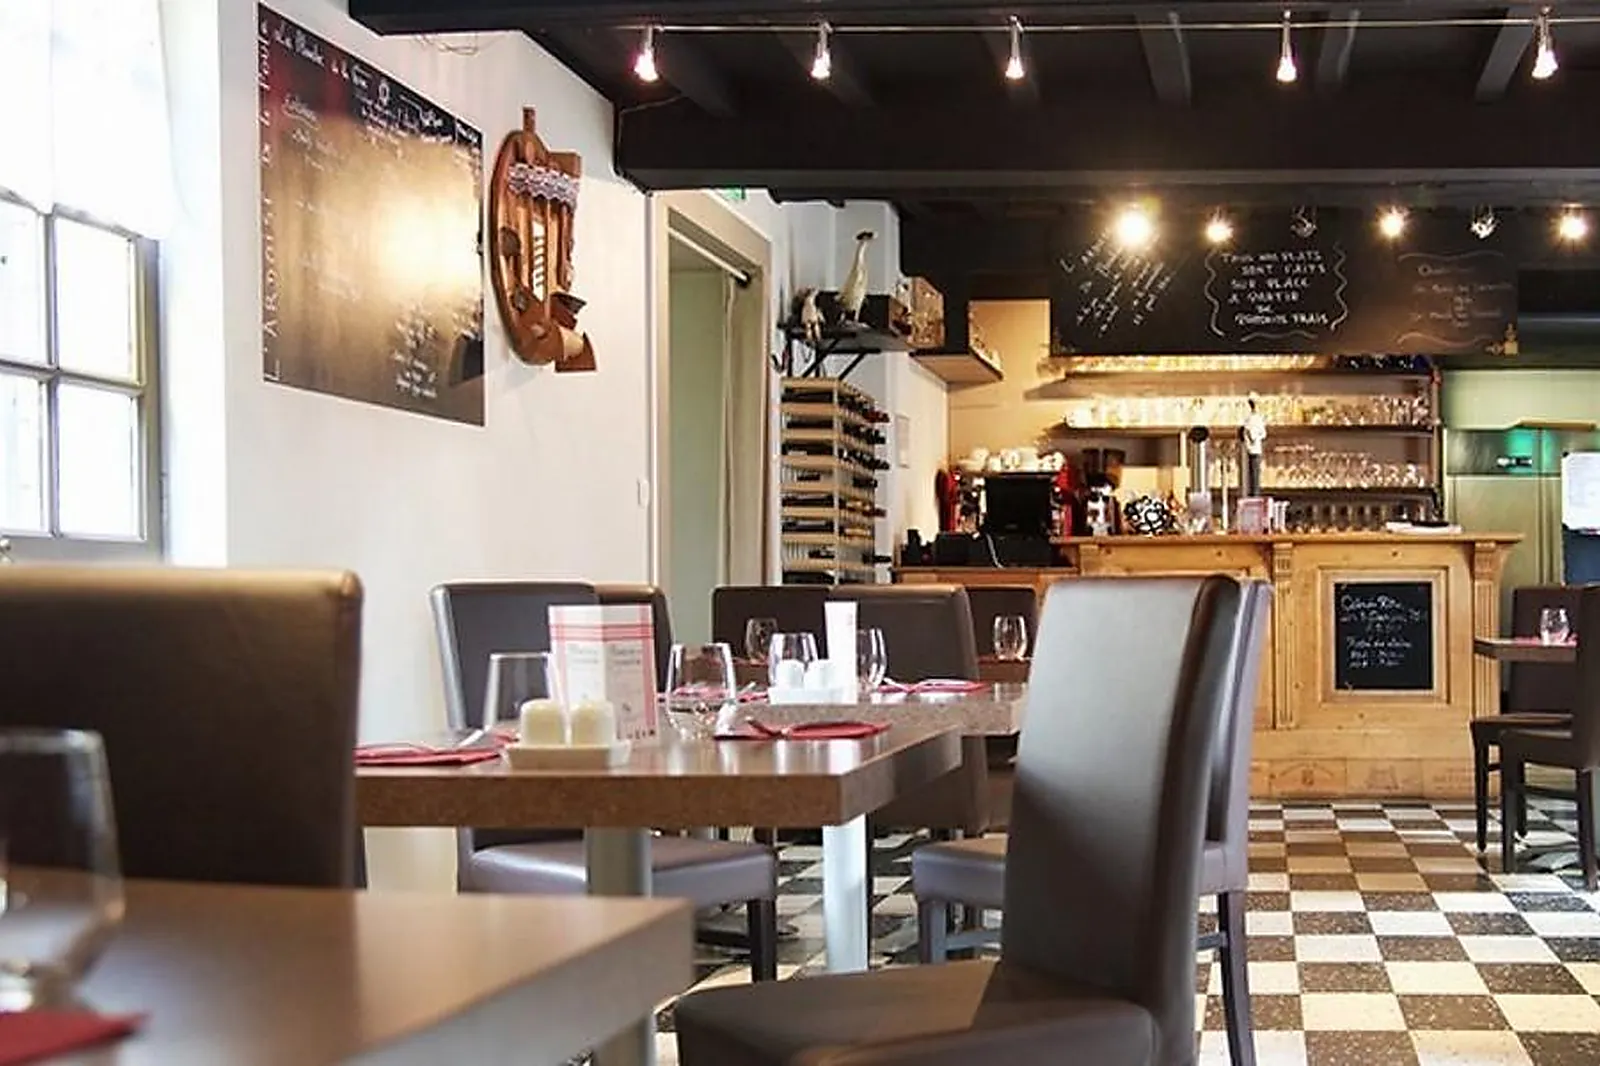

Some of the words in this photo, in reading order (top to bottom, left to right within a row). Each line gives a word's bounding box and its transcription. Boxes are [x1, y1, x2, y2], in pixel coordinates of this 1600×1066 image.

[1281, 250, 1322, 262] PLATS
[1241, 264, 1275, 276] SONT
[1284, 263, 1327, 275] FAITS
[1230, 278, 1256, 290] SUR
[1267, 277, 1309, 290] PLACE
[1247, 290, 1300, 303] PARTIR
[1291, 313, 1329, 325] FRAIS
